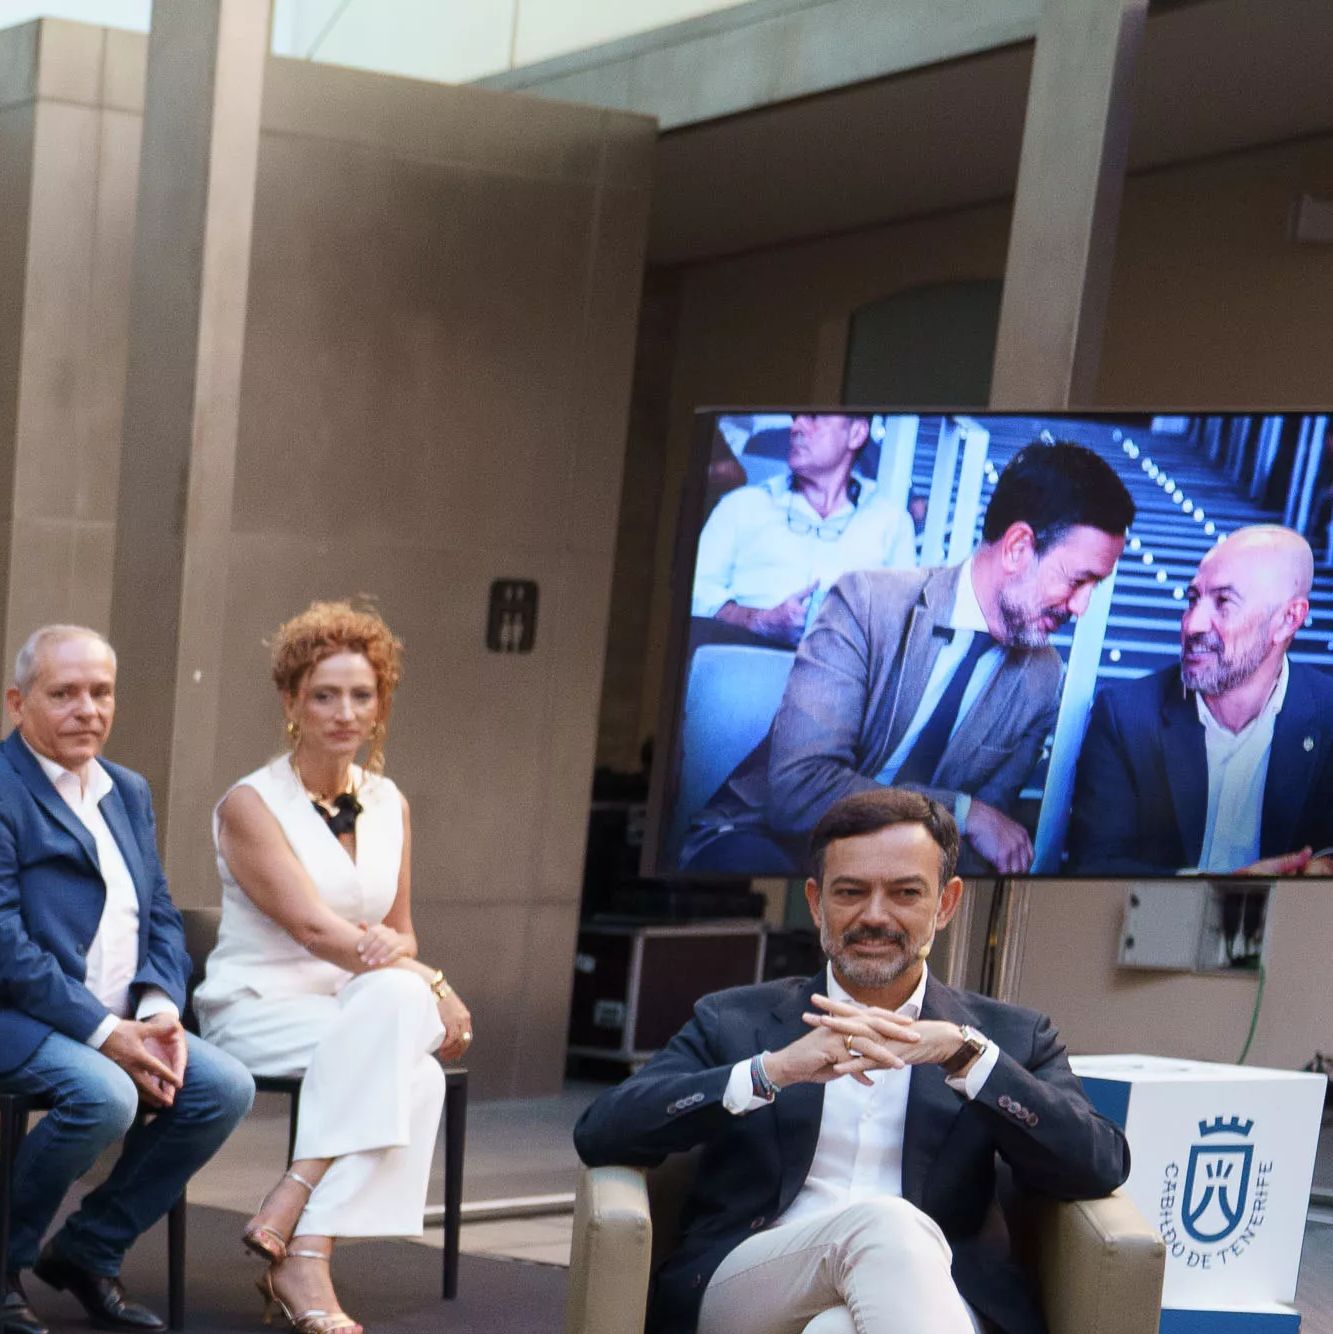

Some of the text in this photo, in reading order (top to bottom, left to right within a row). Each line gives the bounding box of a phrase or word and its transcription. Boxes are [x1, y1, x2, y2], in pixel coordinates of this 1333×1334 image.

[1160, 1160, 1273, 1269] CABILDO DE TENERIFE
